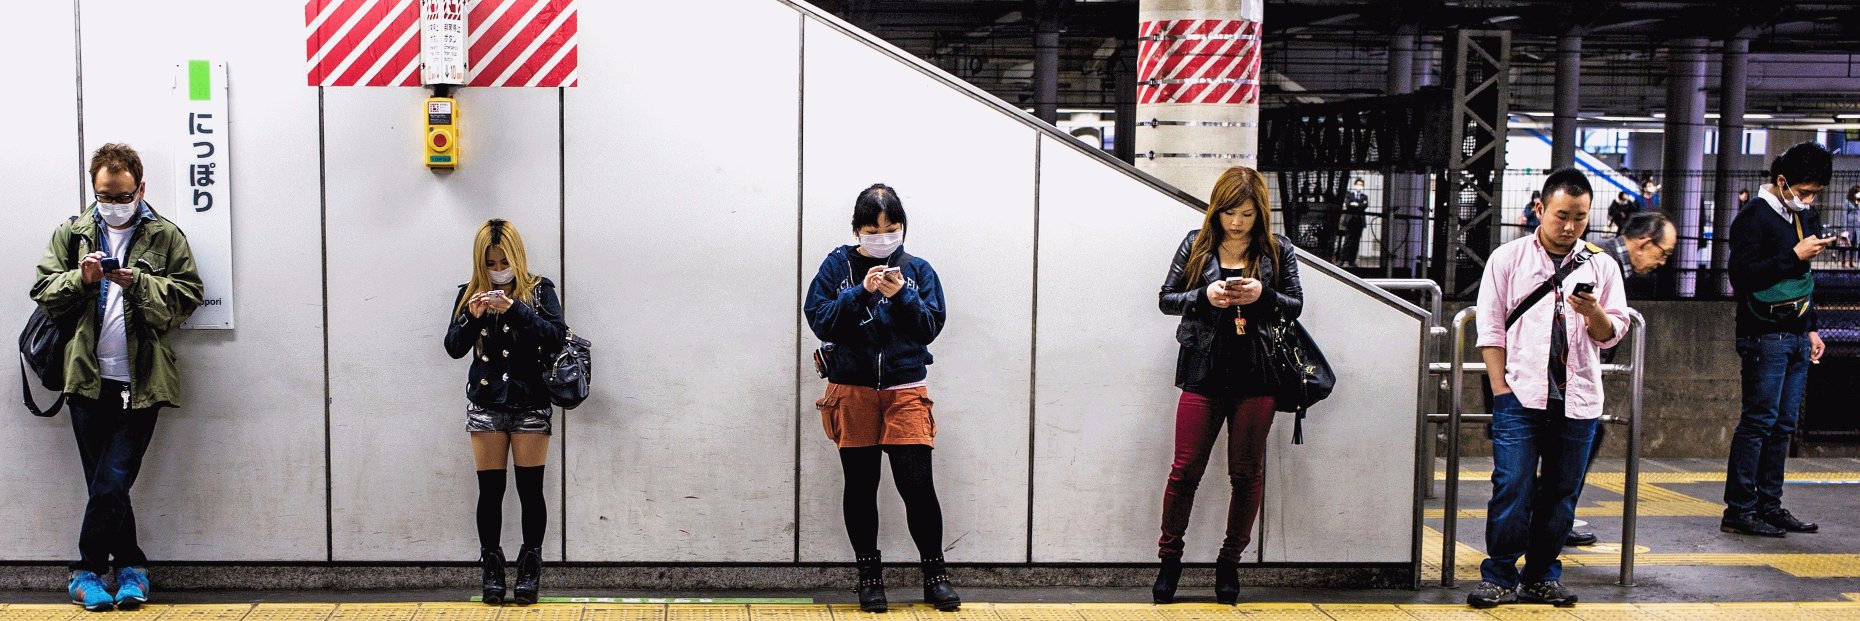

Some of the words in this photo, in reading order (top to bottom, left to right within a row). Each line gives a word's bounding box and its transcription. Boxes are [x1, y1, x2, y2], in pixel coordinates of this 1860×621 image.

[188, 112, 216, 213] にっぽり
[199, 297, 222, 307] ppori
